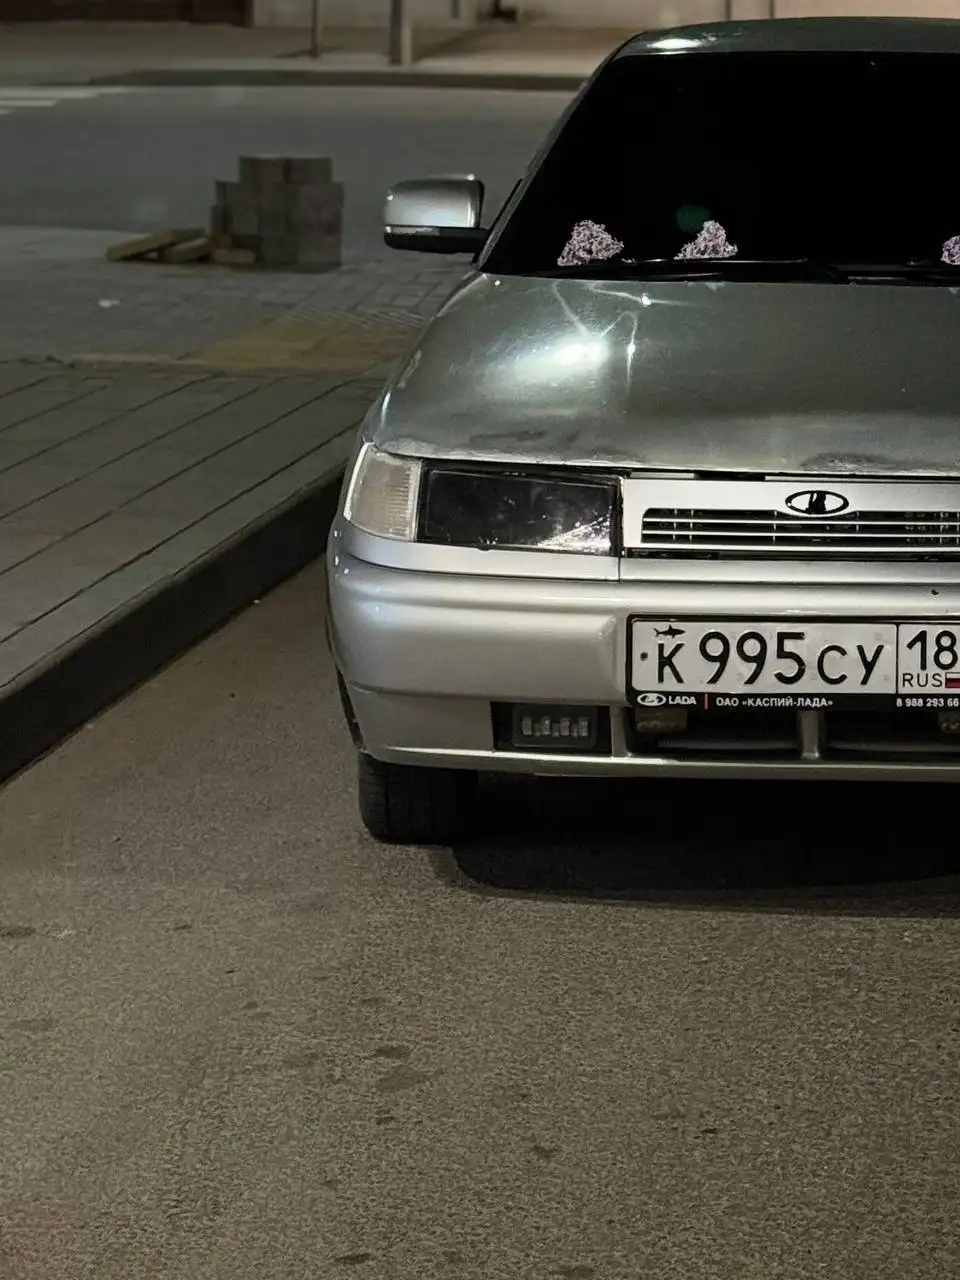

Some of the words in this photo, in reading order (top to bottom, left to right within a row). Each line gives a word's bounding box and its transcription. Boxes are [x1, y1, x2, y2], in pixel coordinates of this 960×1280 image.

[906, 630, 958, 671] 18
[902, 673, 943, 688] RUS
[668, 696, 697, 705] LADA
[716, 697, 739, 707] ОАО
